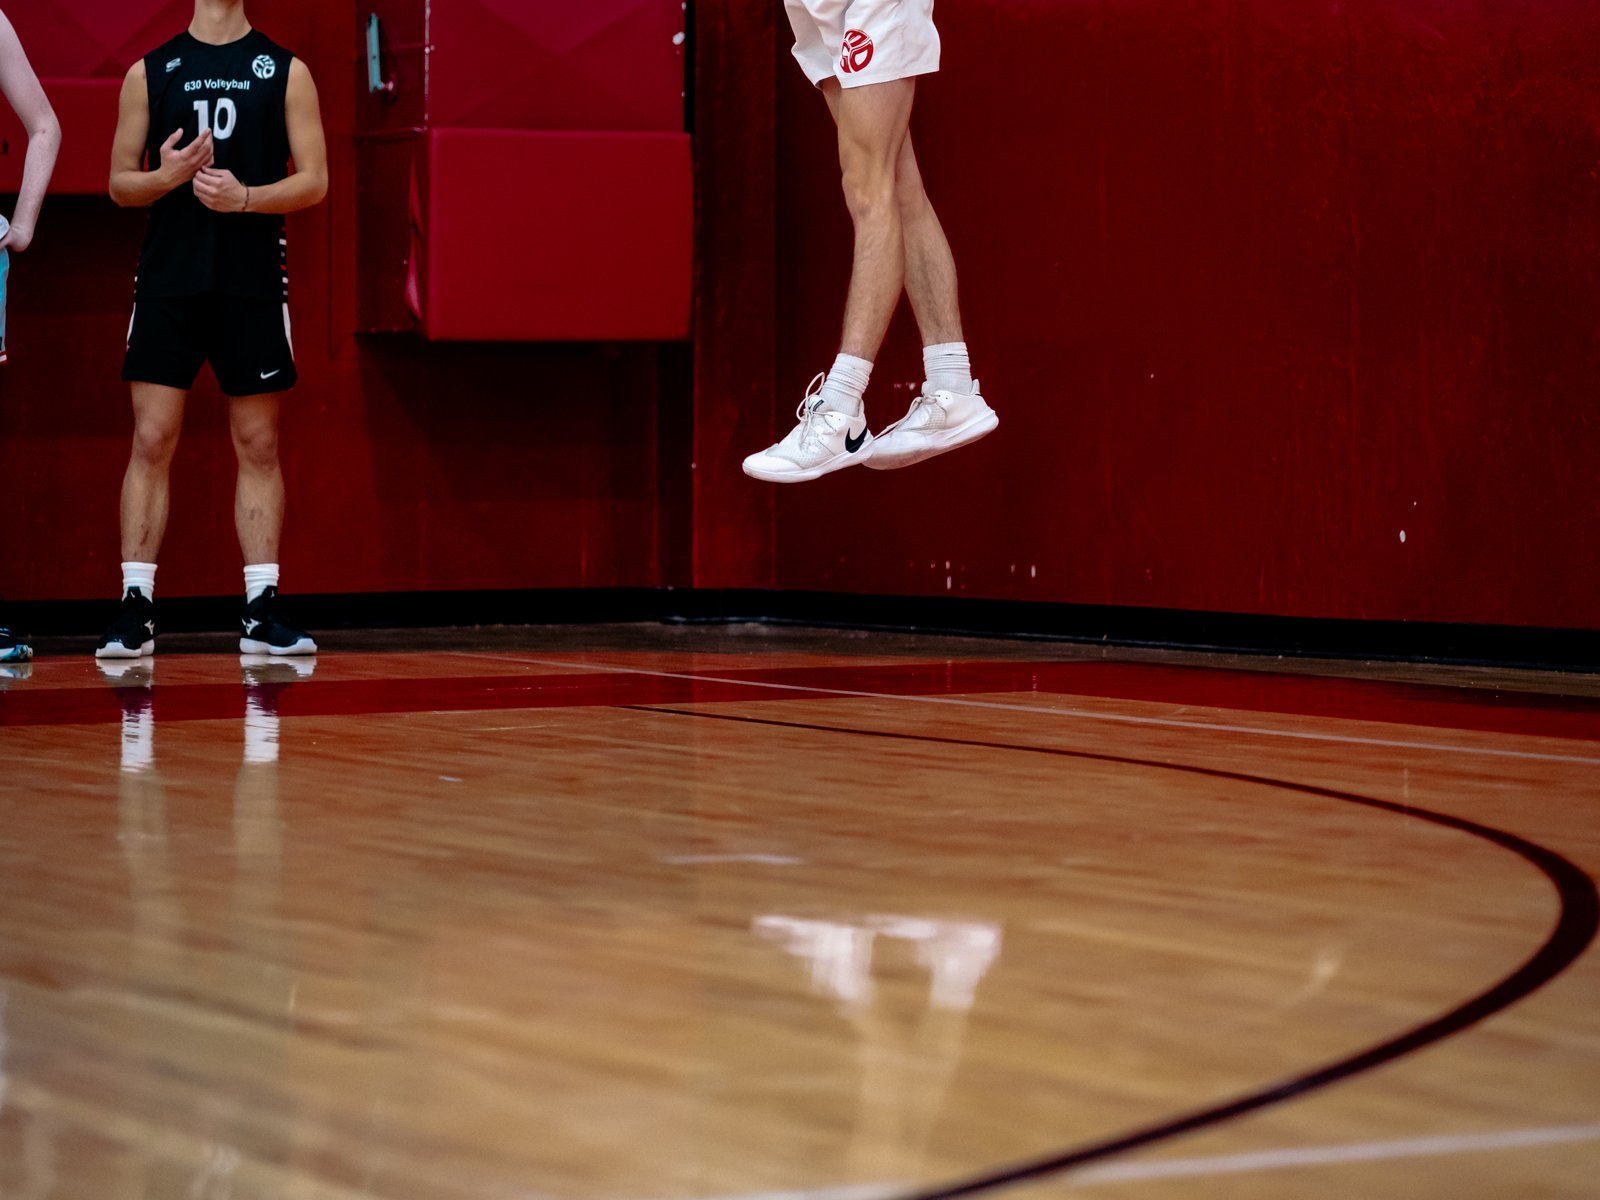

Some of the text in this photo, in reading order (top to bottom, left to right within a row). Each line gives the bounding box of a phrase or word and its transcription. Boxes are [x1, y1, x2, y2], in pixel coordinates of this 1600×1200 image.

[184, 79, 250, 92] 630 Voleyball
[193, 97, 237, 140] 10
